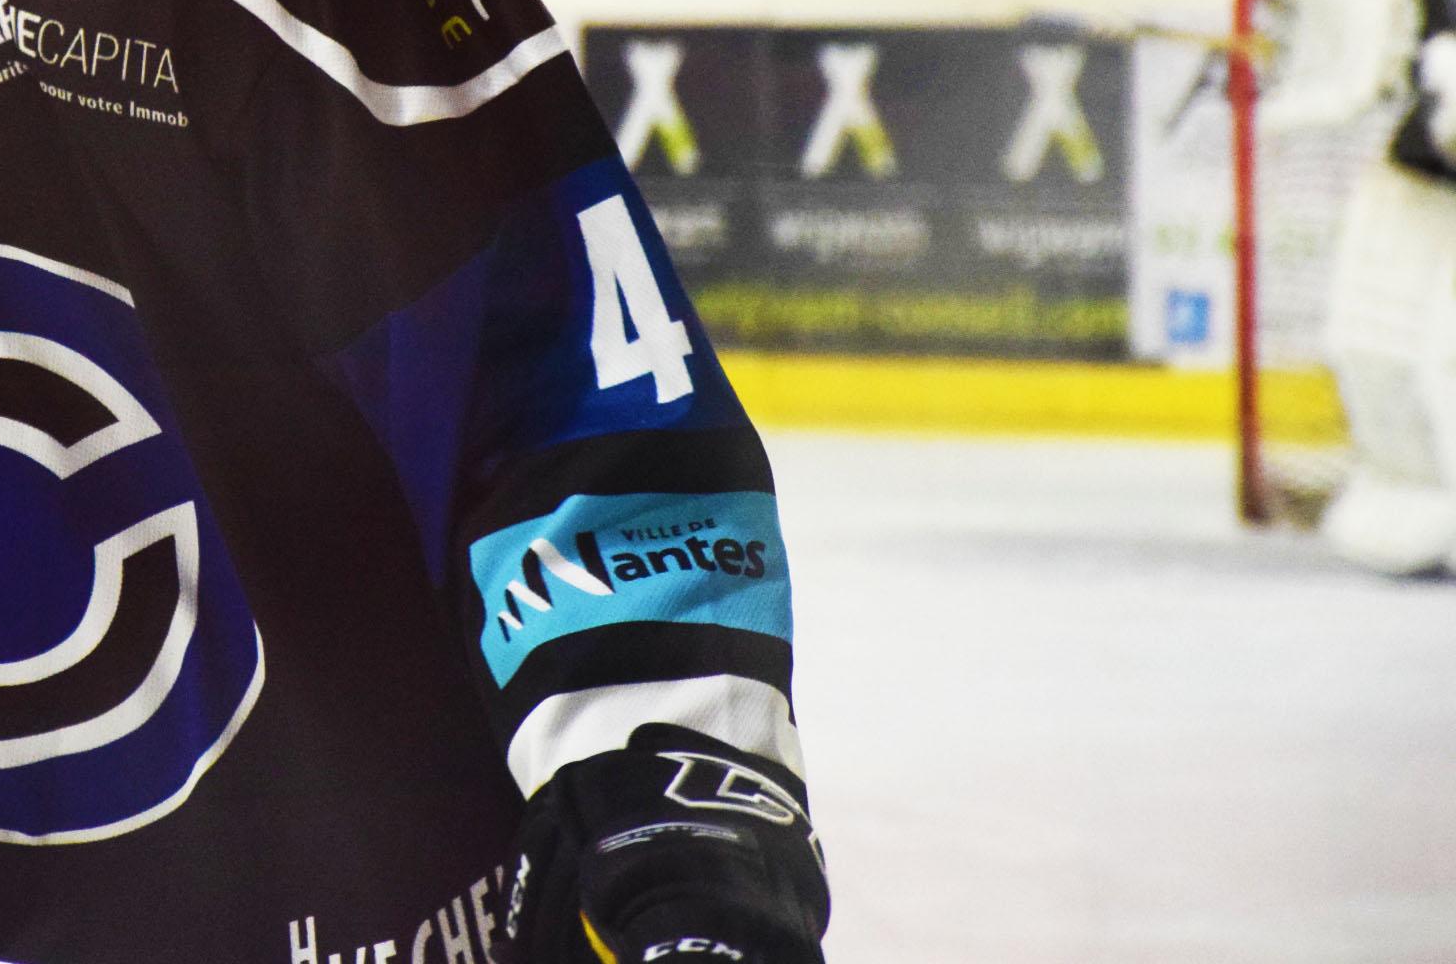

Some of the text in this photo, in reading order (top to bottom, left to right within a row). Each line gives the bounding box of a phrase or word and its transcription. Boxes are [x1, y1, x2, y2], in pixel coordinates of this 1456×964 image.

[77, 93, 124, 115] votre
[576, 194, 694, 405] 4
[622, 517, 718, 541] VILLE DE
[643, 937, 743, 962] CCM
